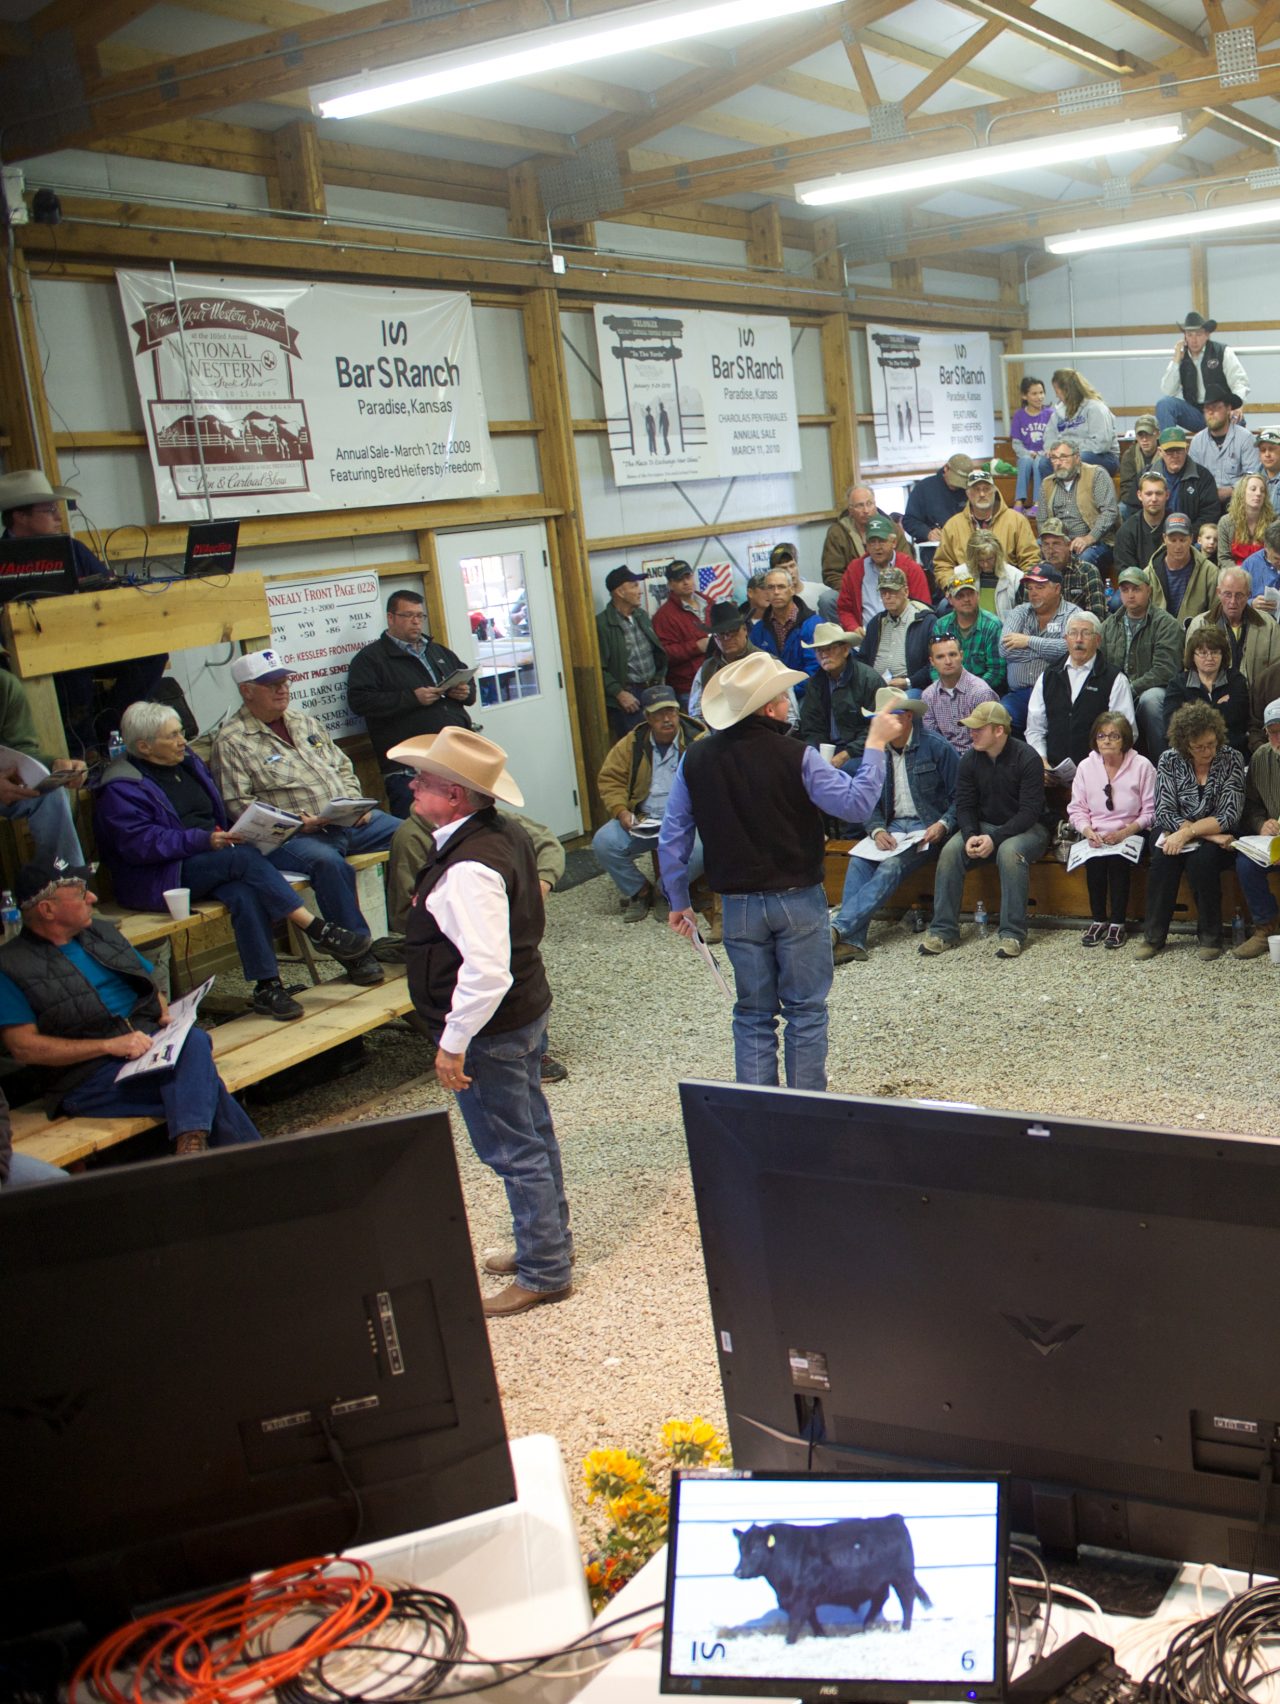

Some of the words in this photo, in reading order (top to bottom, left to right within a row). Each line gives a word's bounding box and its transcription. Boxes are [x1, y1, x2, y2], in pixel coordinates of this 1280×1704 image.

[180, 302, 207, 326] Your
[200, 299, 248, 325] Western
[247, 309, 285, 332] Spirit
[167, 338, 252, 359] NATIONAL
[335, 356, 375, 388] Bar
[377, 356, 393, 388] S
[393, 356, 460, 388] Ranch
[712, 355, 736, 379] Bar
[736, 355, 745, 379] S
[745, 356, 784, 379] Ranch
[939, 365, 954, 385] Bar
[954, 365, 961, 385] S
[960, 366, 986, 385] Ranch
[724, 387, 755, 401] Paradise,
[755, 387, 778, 400] Kansas
[358, 398, 411, 416] Paradise,
[410, 398, 453, 414] Kansas
[733, 430, 760, 440] ANNUAL
[761, 429, 776, 439] SALE
[336, 447, 369, 460] Annual
[370, 444, 389, 459] Sale
[394, 442, 425, 457] March
[447, 440, 471, 454] 2009
[731, 445, 756, 455] MARCH
[227, 473, 263, 489] Carload
[263, 471, 287, 486] Show
[330, 466, 377, 483] Featuring
[377, 466, 400, 479] Bred
[400, 463, 434, 478] Heifers
[444, 460, 483, 475] Freedom
[304, 587, 333, 602] FRONT
[334, 583, 356, 598] PAGE
[357, 581, 376, 593] 0228
[298, 621, 315, 630] WW
[325, 617, 339, 625] YW
[349, 612, 371, 621] MILK
[297, 648, 328, 661] KESSLERS
[329, 642, 367, 656] FRONTMAN
[312, 667, 328, 679] PAGE
[310, 684, 333, 697] BARN
[322, 709, 349, 721] SEMEN
